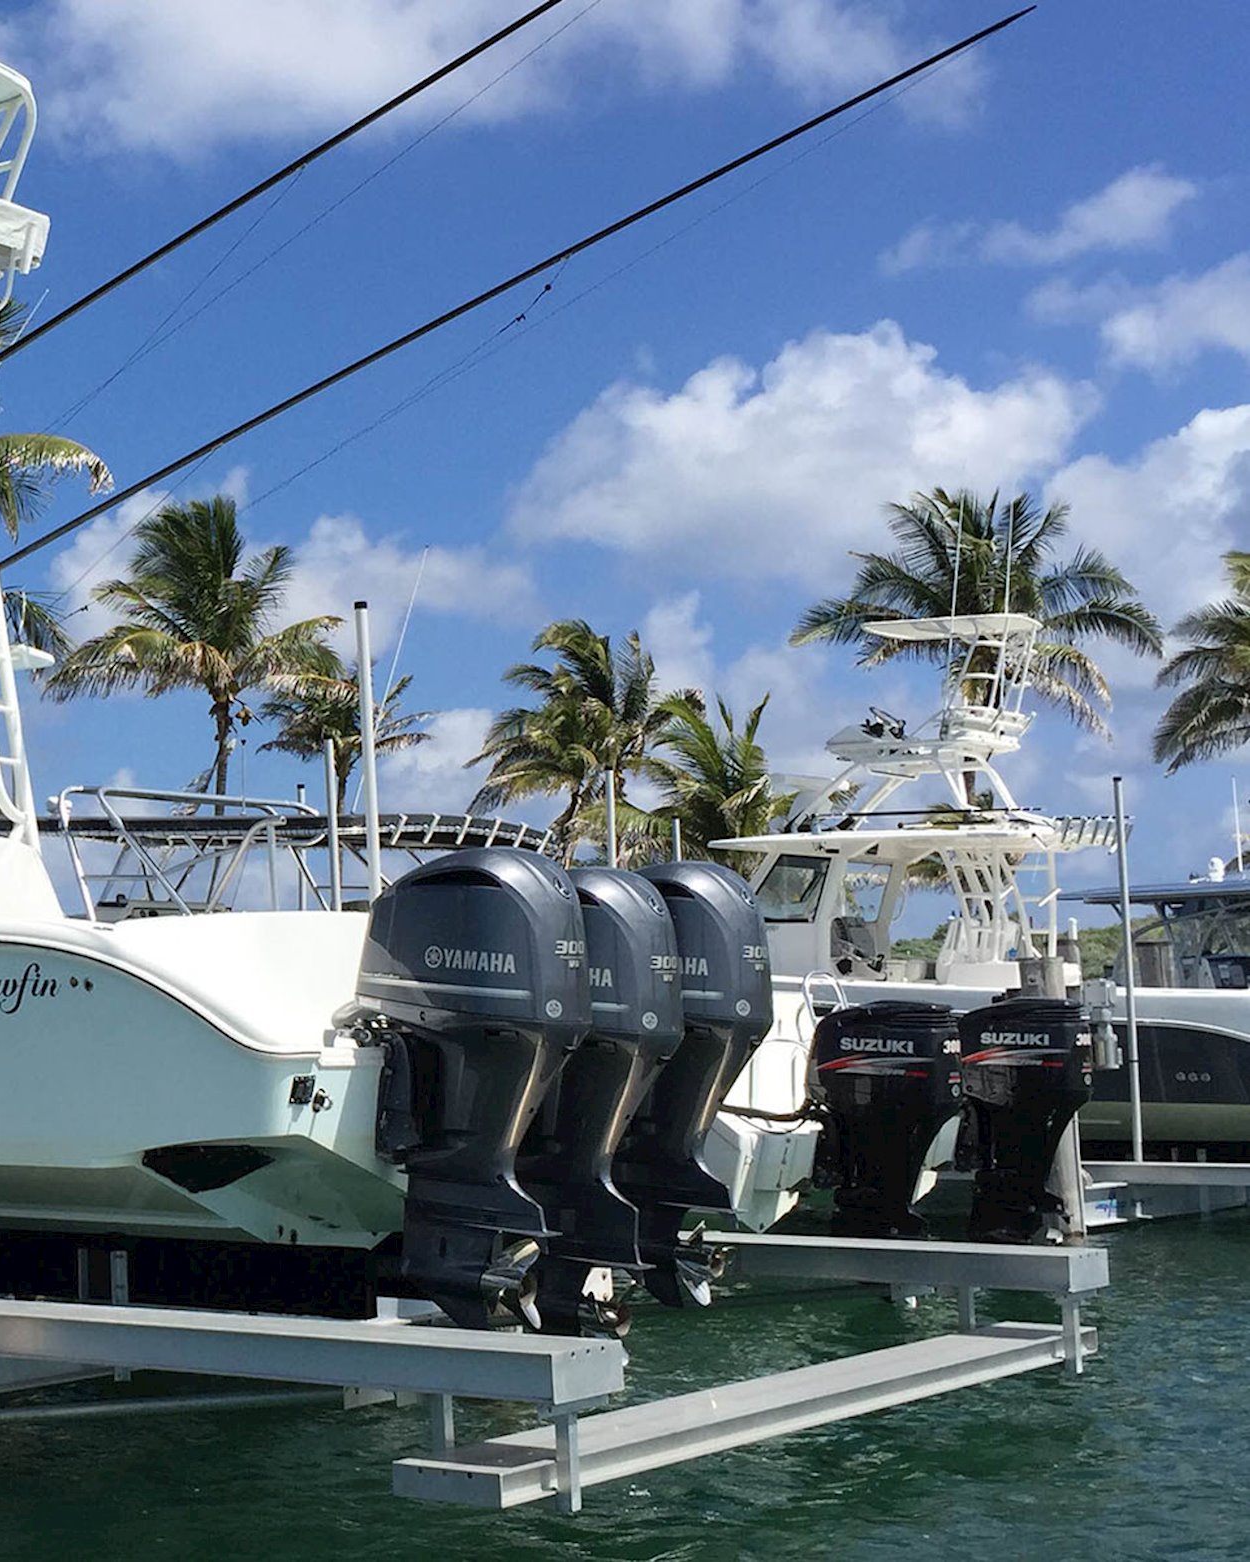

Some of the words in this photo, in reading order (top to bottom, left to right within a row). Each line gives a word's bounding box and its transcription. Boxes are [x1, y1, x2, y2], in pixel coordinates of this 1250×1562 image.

[554, 940, 585, 955] 300
[443, 948, 516, 974] YAMAHA
[650, 955, 678, 970] 300
[839, 1037, 915, 1055] SUZUKI
[979, 1031, 1050, 1047] SUZUKI
